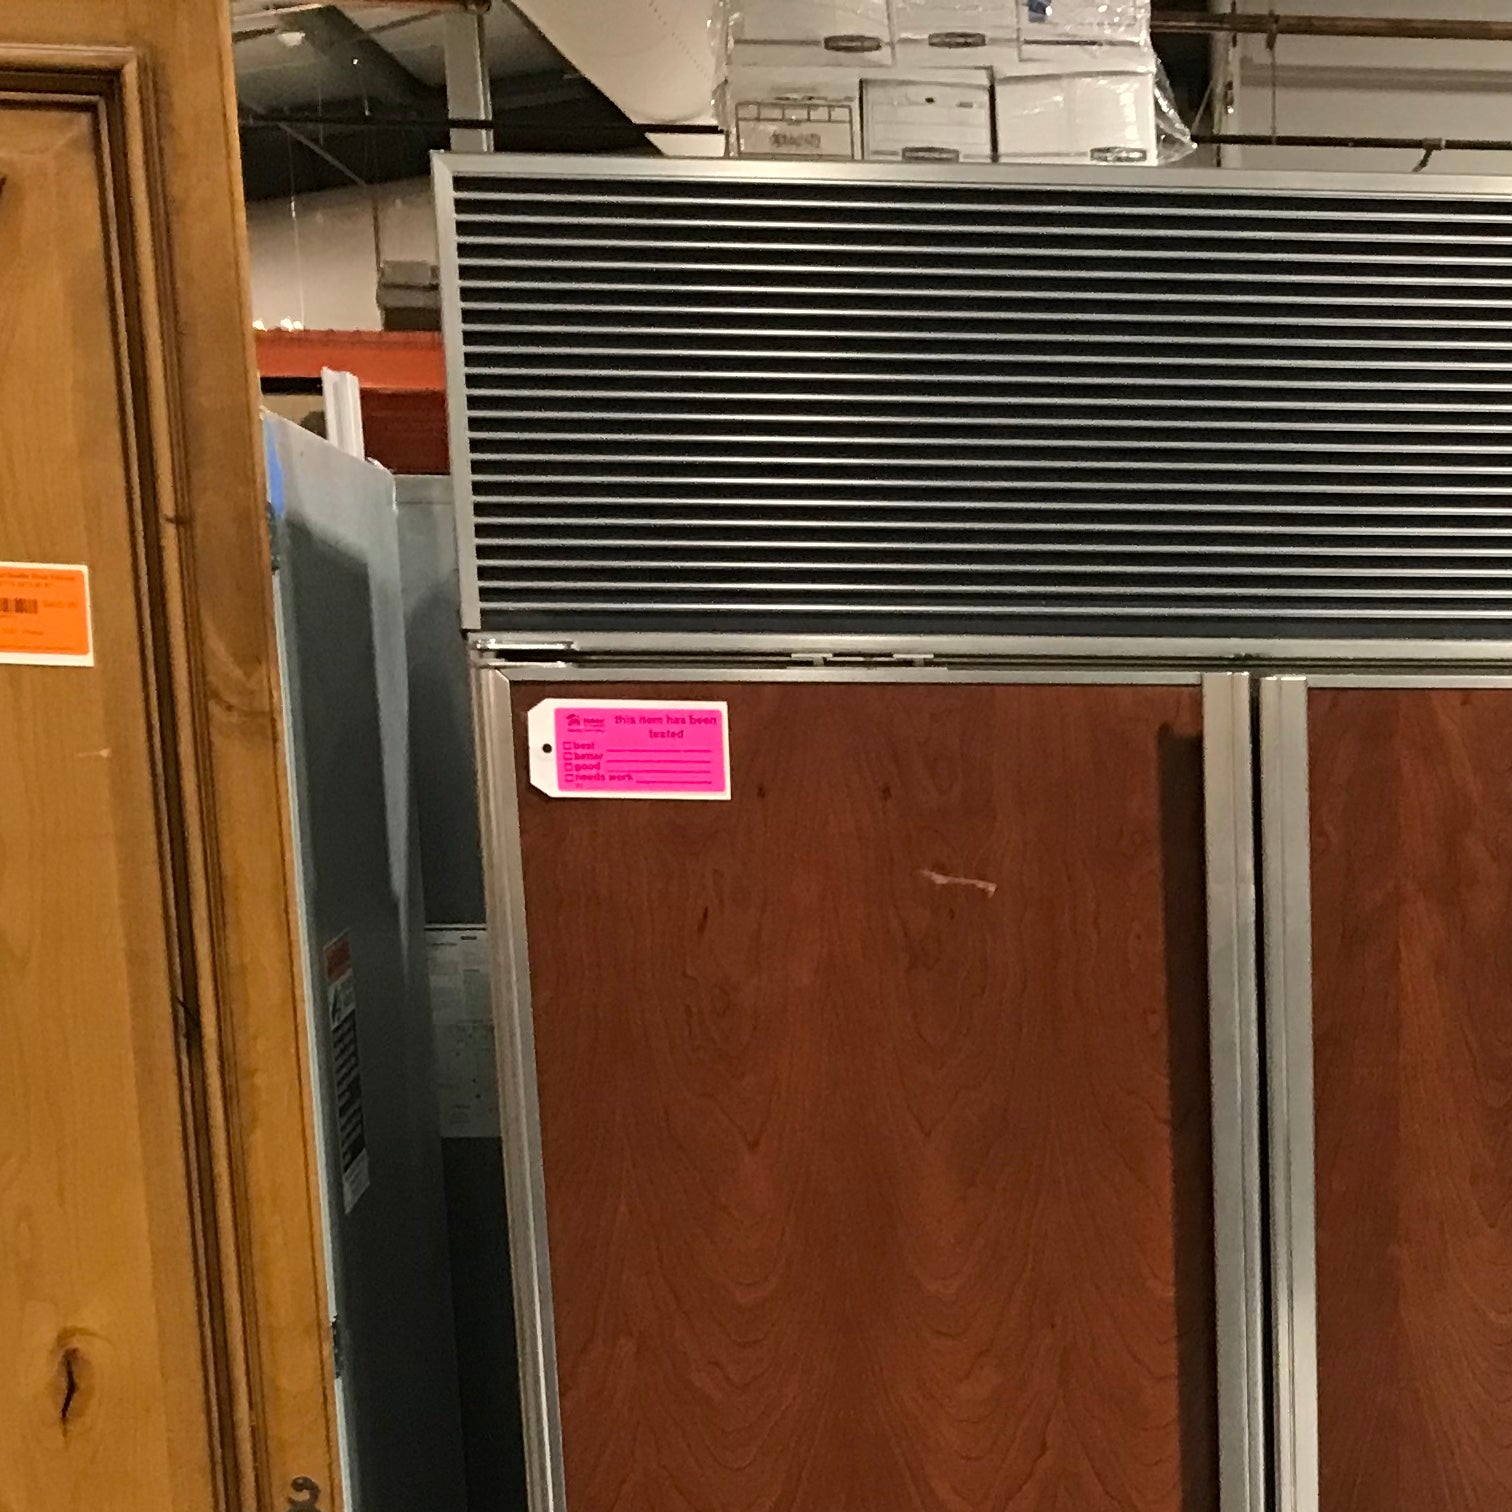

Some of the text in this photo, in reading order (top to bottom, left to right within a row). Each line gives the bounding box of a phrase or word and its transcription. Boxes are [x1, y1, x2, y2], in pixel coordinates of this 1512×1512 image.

[614, 714, 637, 725] this
[638, 715, 664, 725] item
[665, 714, 687, 725] has
[648, 728, 685, 740] tested
